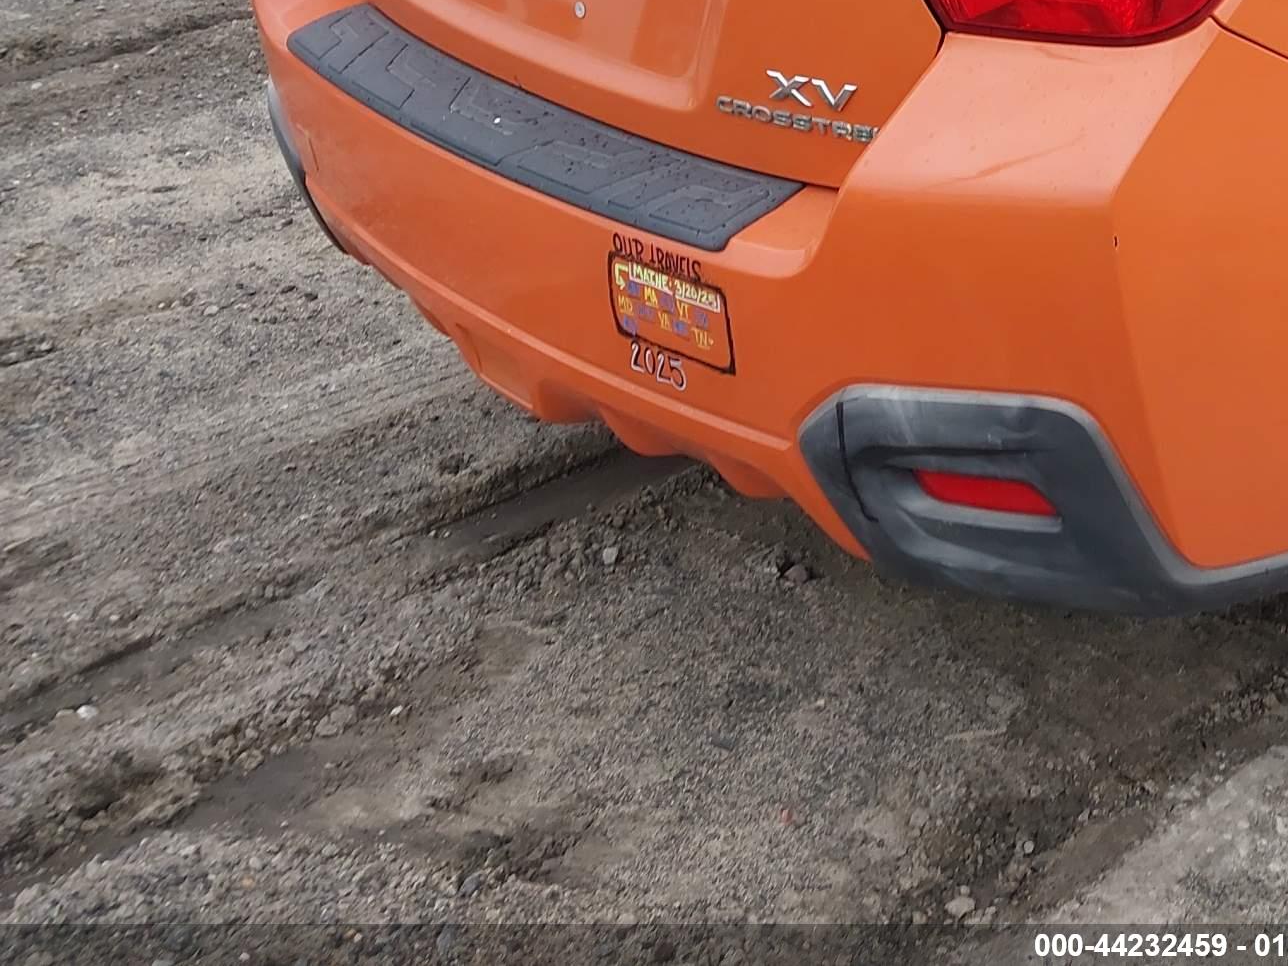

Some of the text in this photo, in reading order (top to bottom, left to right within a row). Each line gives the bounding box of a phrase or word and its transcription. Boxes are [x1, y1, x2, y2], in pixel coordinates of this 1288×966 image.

[766, 69, 857, 112] XV
[715, 96, 880, 144] CROSSTRE
[613, 232, 644, 262] OUR
[631, 341, 687, 391] 2025
